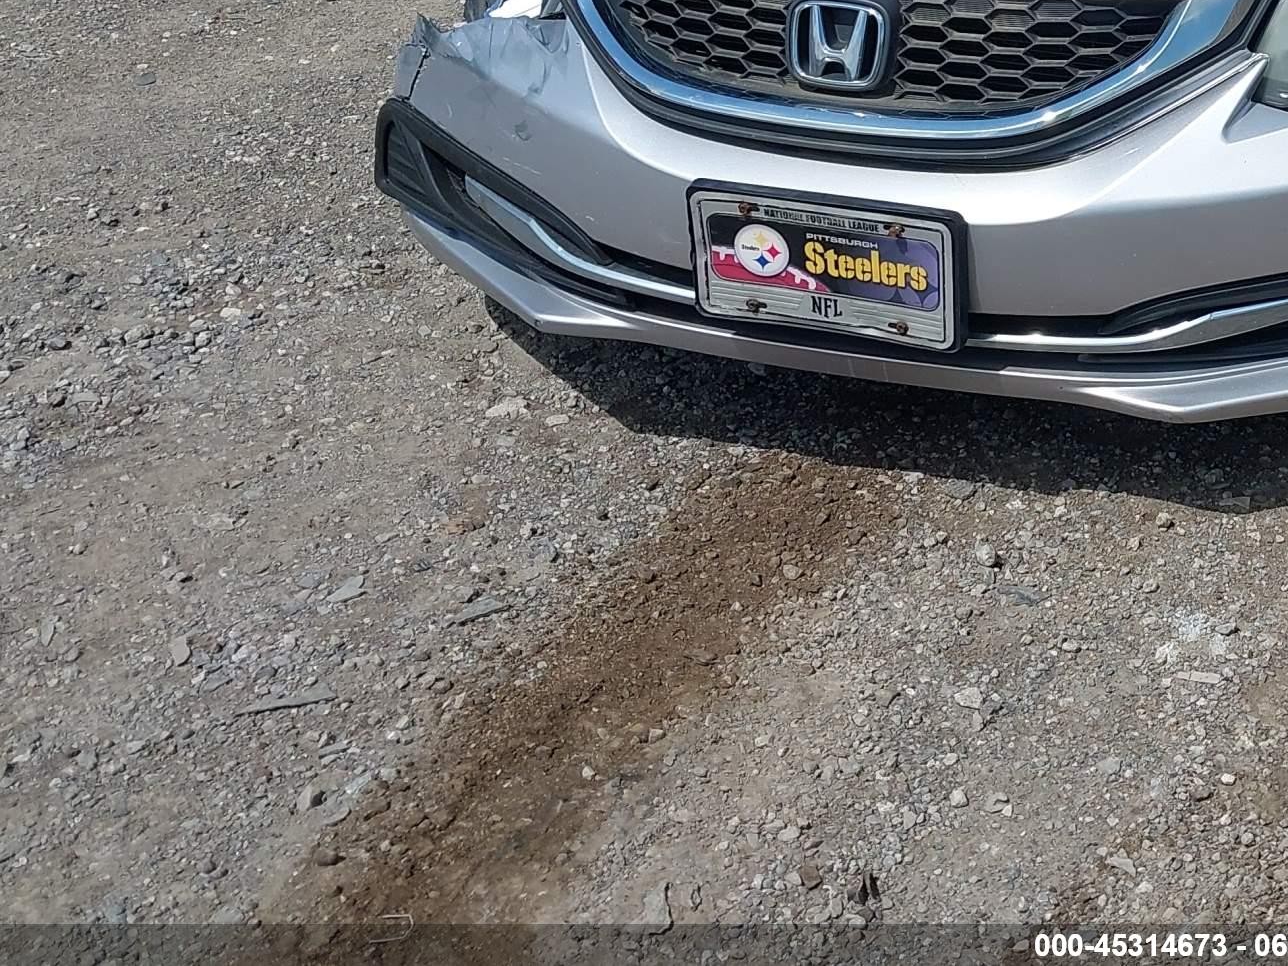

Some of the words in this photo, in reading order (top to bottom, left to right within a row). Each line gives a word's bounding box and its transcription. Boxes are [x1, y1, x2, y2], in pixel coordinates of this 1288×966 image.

[763, 208, 804, 223] NATIONAL
[805, 213, 847, 228] FOOTBALL
[847, 218, 880, 233] LEAGUE
[741, 243, 760, 252] Steelers
[805, 232, 879, 249] PITTSBURGH
[803, 240, 928, 292] Steelers
[810, 296, 843, 319] NFL
